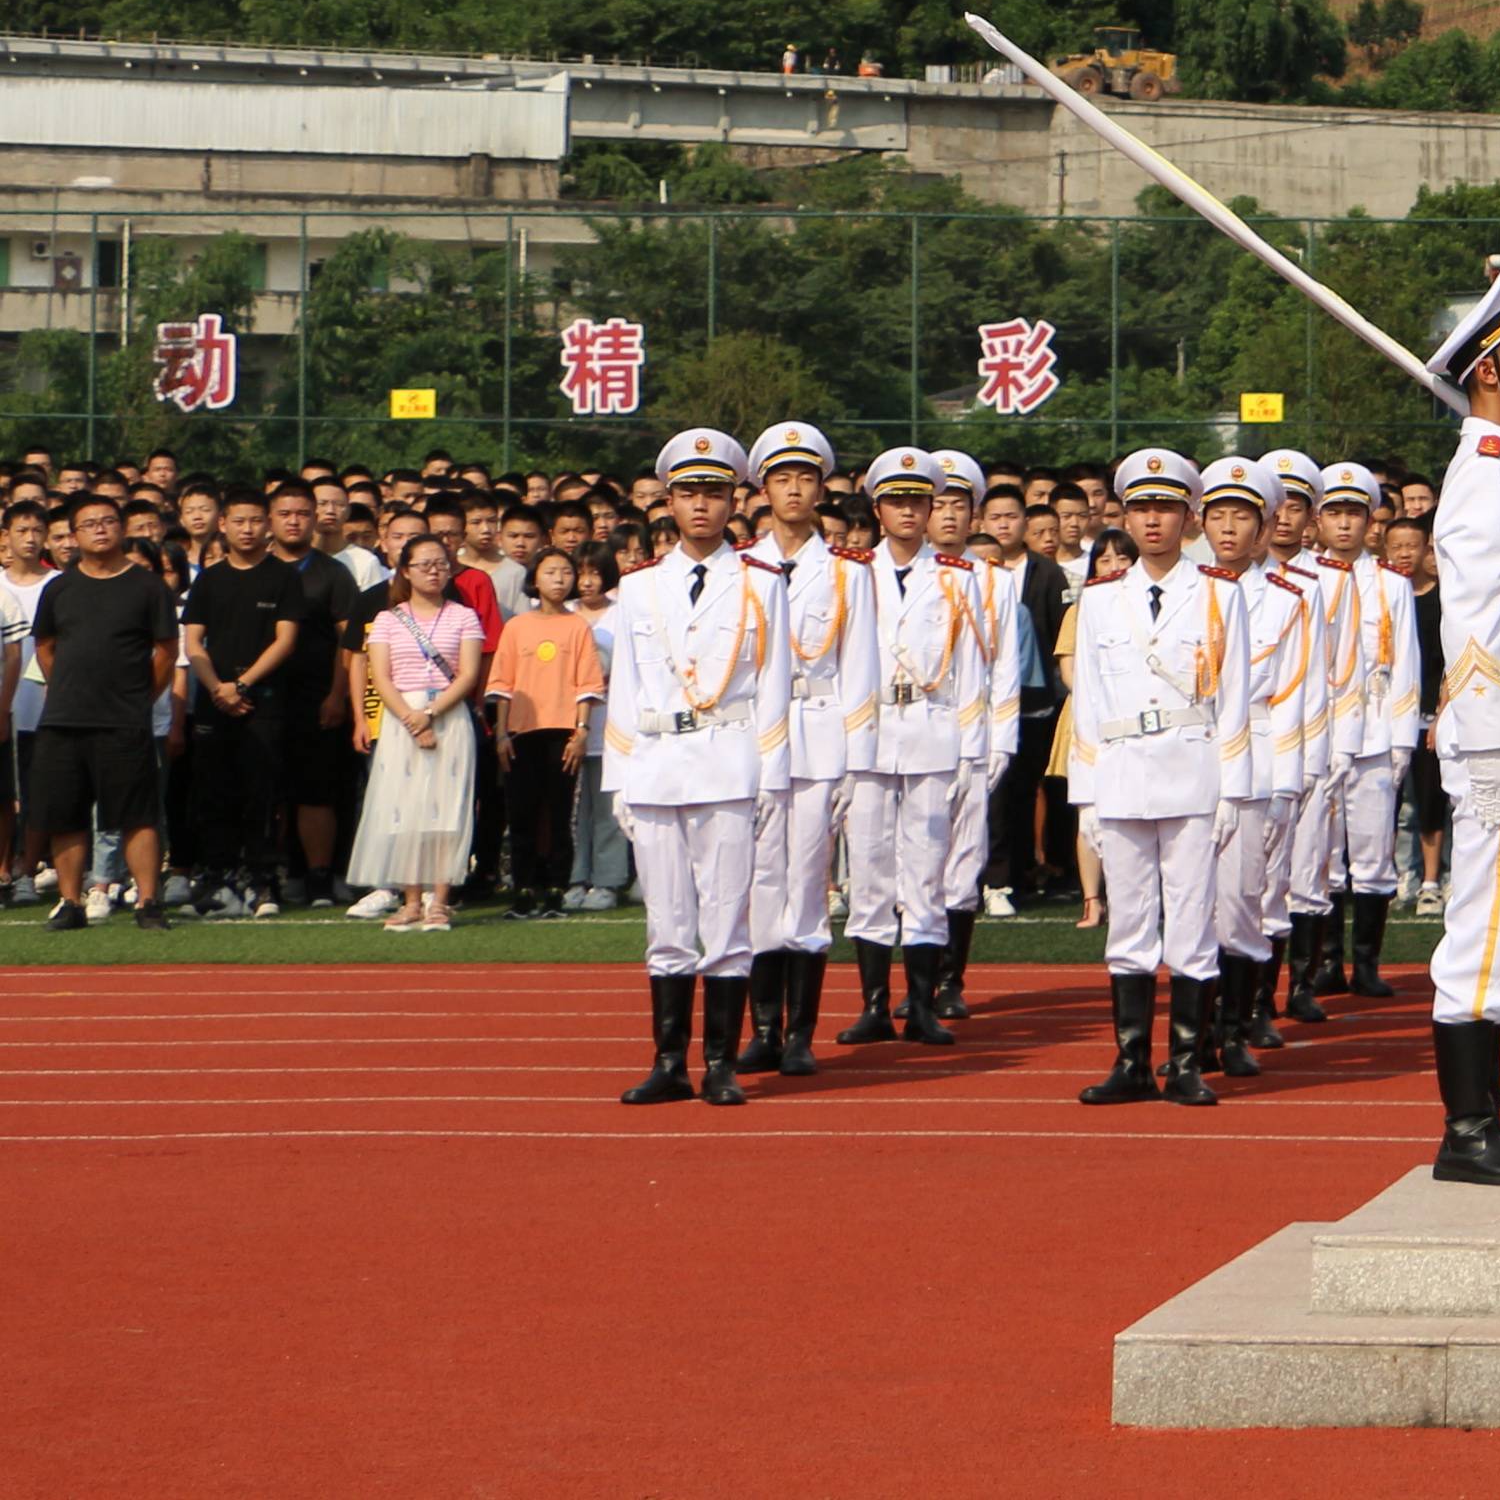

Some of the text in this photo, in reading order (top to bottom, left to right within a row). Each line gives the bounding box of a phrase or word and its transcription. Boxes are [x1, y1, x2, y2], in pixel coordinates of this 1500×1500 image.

[155, 315, 234, 411] 动
[561, 319, 644, 412] 精
[978, 318, 1058, 413] 彩
